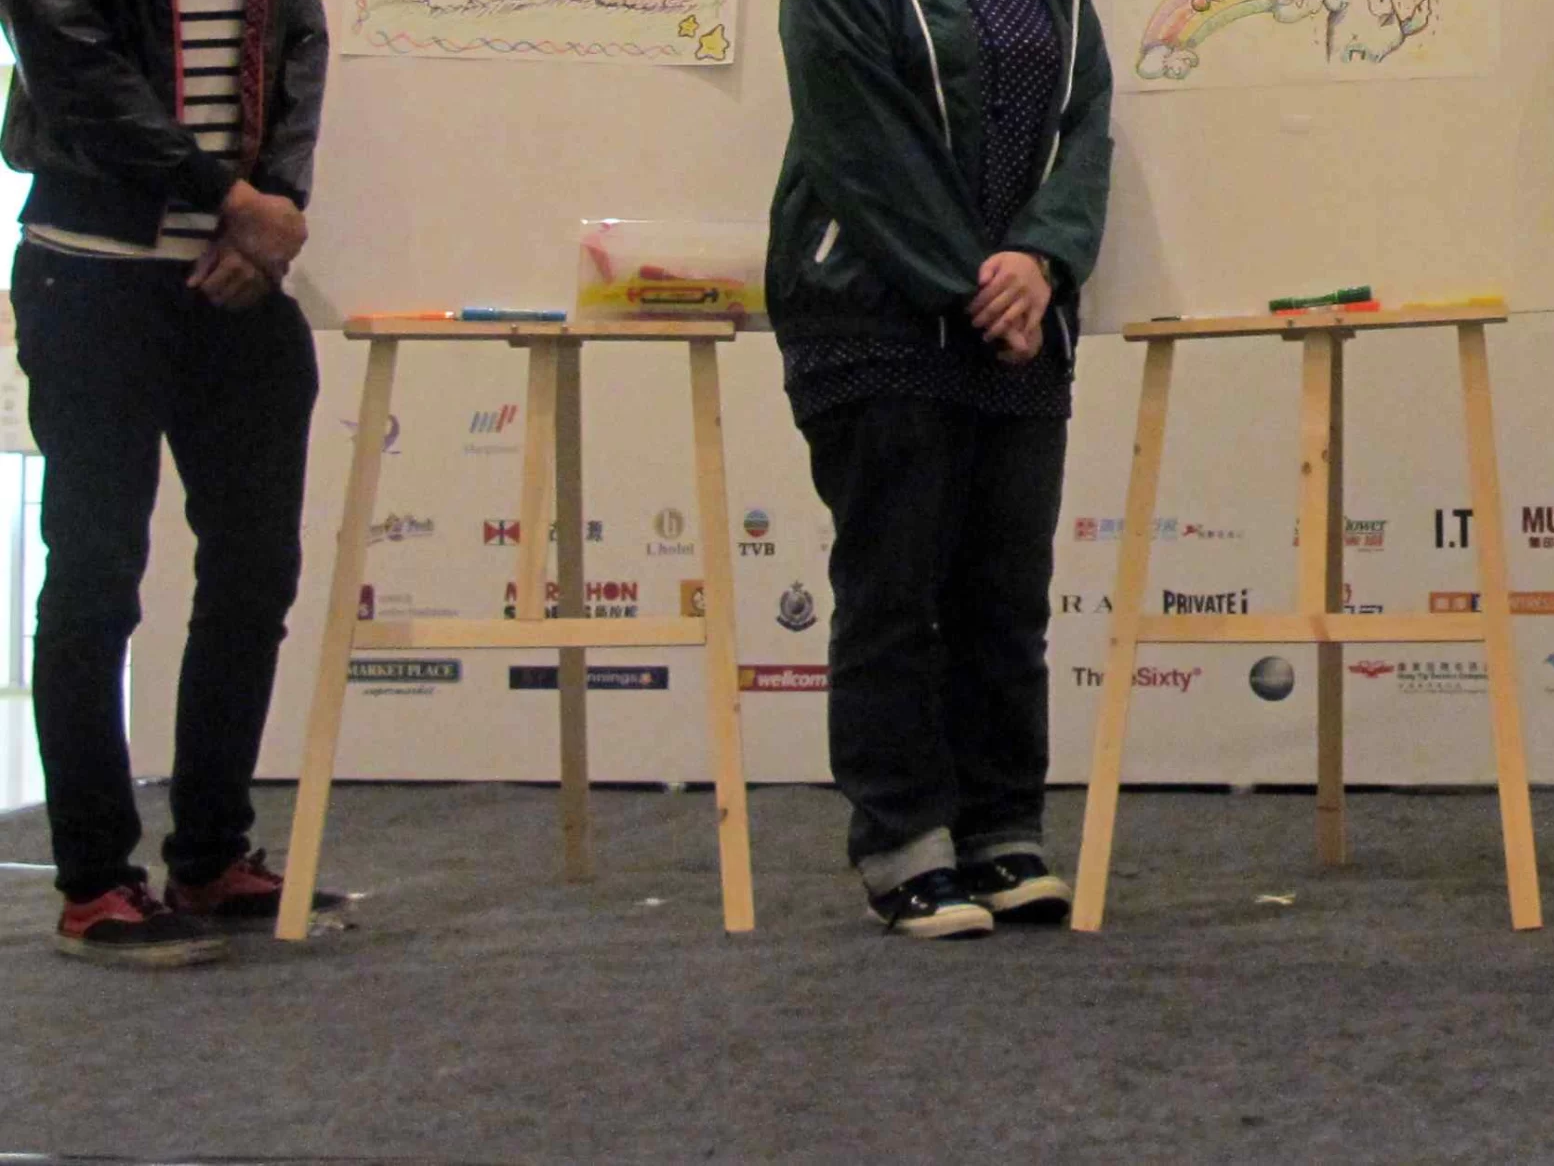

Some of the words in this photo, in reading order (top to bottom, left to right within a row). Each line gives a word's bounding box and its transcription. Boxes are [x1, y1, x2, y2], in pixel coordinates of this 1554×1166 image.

[1435, 508, 1474, 549] I.T
[738, 541, 776, 557] TVB
[1060, 593, 1113, 614] RA
[1163, 590, 1236, 615] PRIVATE
[757, 669, 829, 688] wellcom
